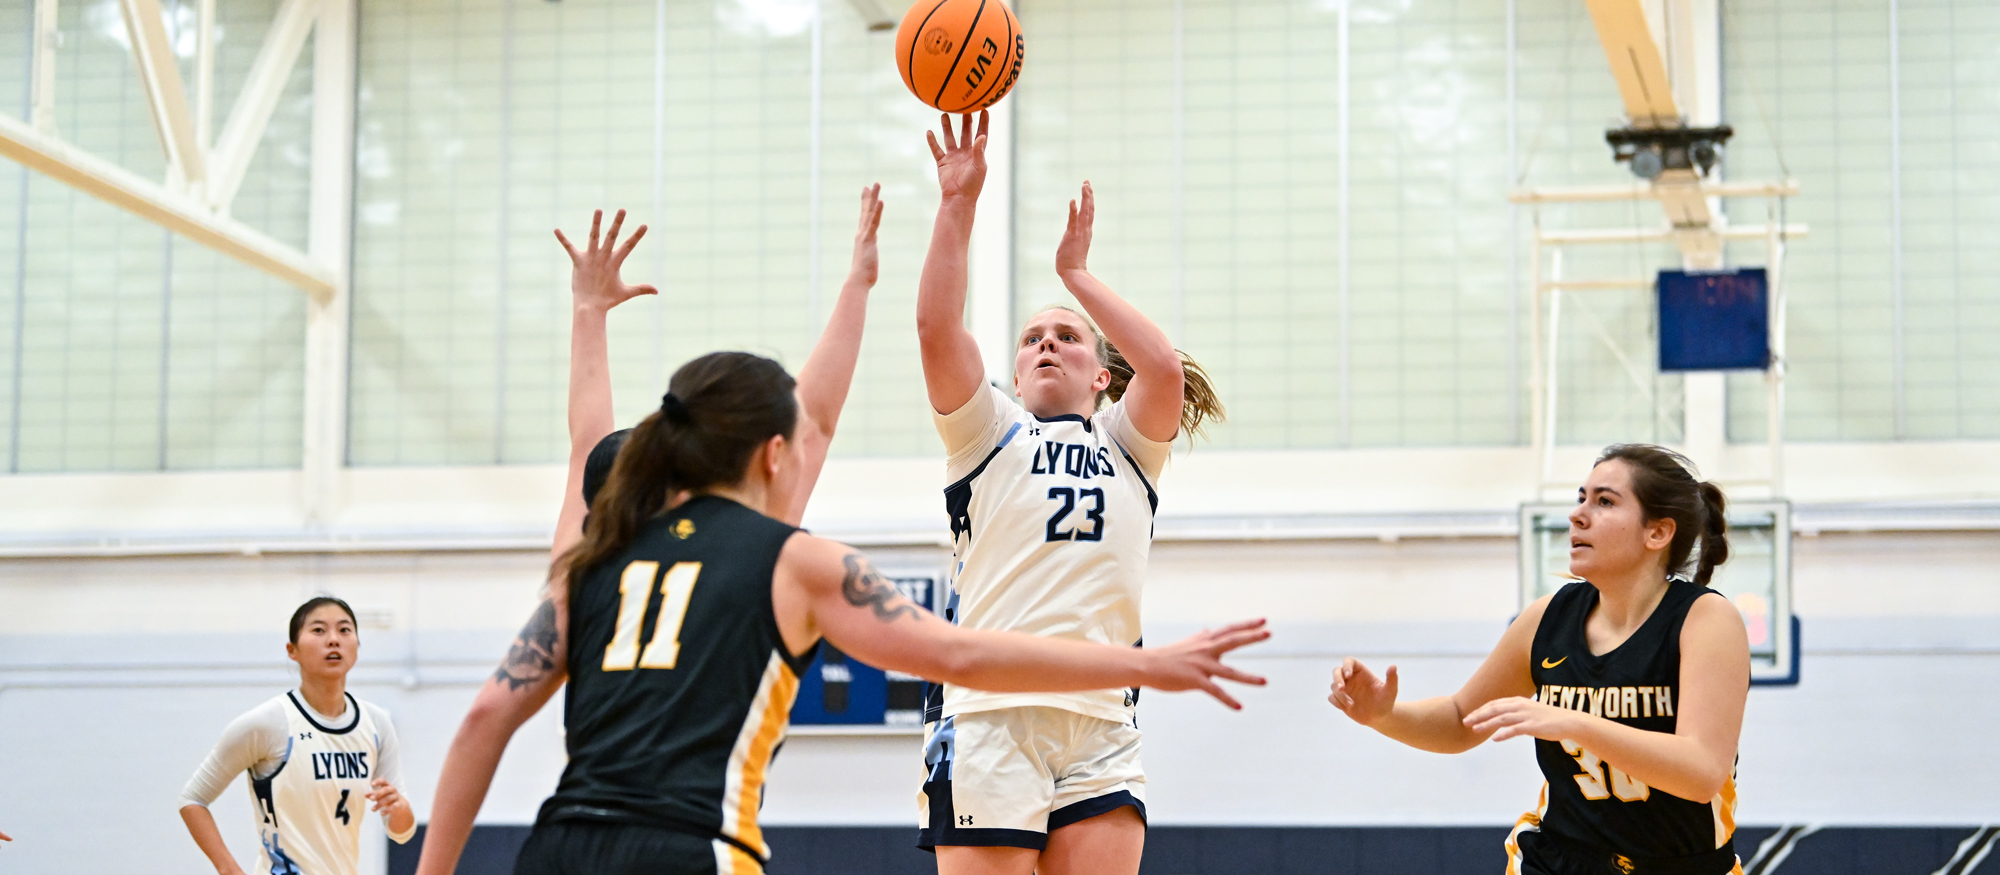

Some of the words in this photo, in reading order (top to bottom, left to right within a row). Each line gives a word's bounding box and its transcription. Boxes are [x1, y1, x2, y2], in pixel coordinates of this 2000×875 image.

[965, 36, 998, 90] EVO
[1030, 440, 1116, 479] LYONS
[1045, 487, 1105, 542] 23
[602, 559, 703, 672] 11
[1539, 684, 1674, 719] WENTWORTH
[311, 752, 369, 780] LYONS
[335, 788, 351, 826] 4
